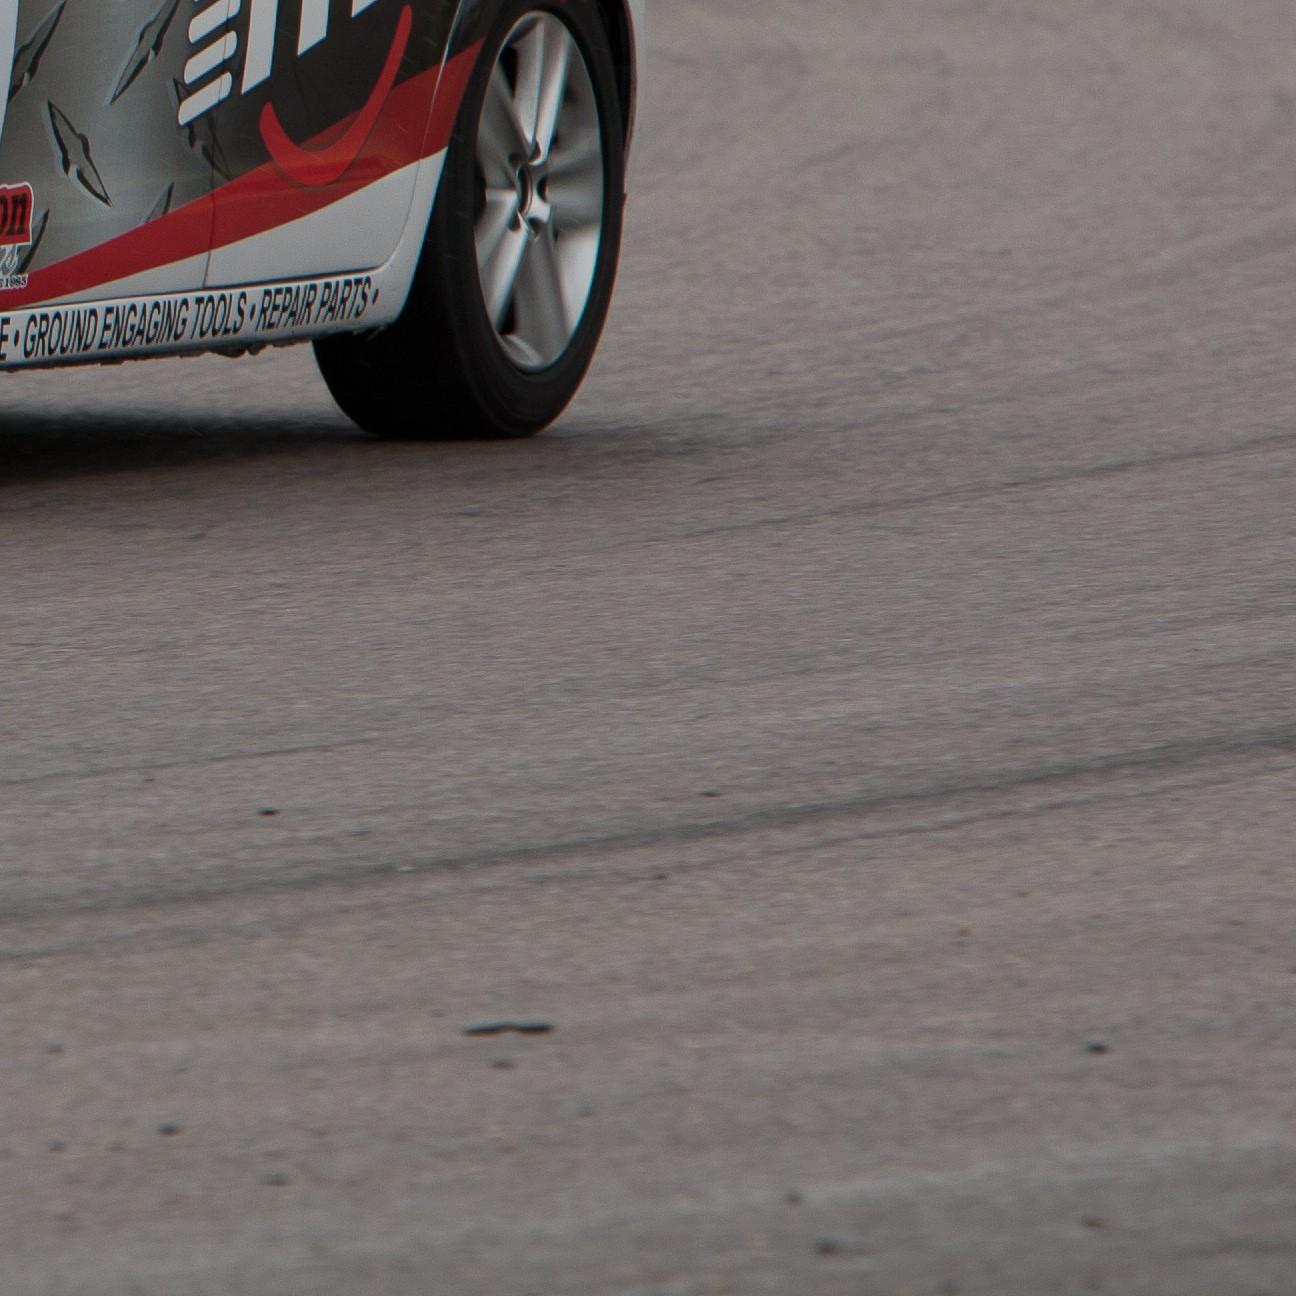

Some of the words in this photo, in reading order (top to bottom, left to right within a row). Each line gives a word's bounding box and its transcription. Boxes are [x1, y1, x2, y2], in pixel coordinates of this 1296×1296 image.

[22, 304, 99, 360] GROUND
[97, 297, 190, 350] ENGAGING
[189, 291, 249, 340] TOOLS
[254, 284, 318, 333] REPAIR
[311, 275, 372, 326] PARTS
